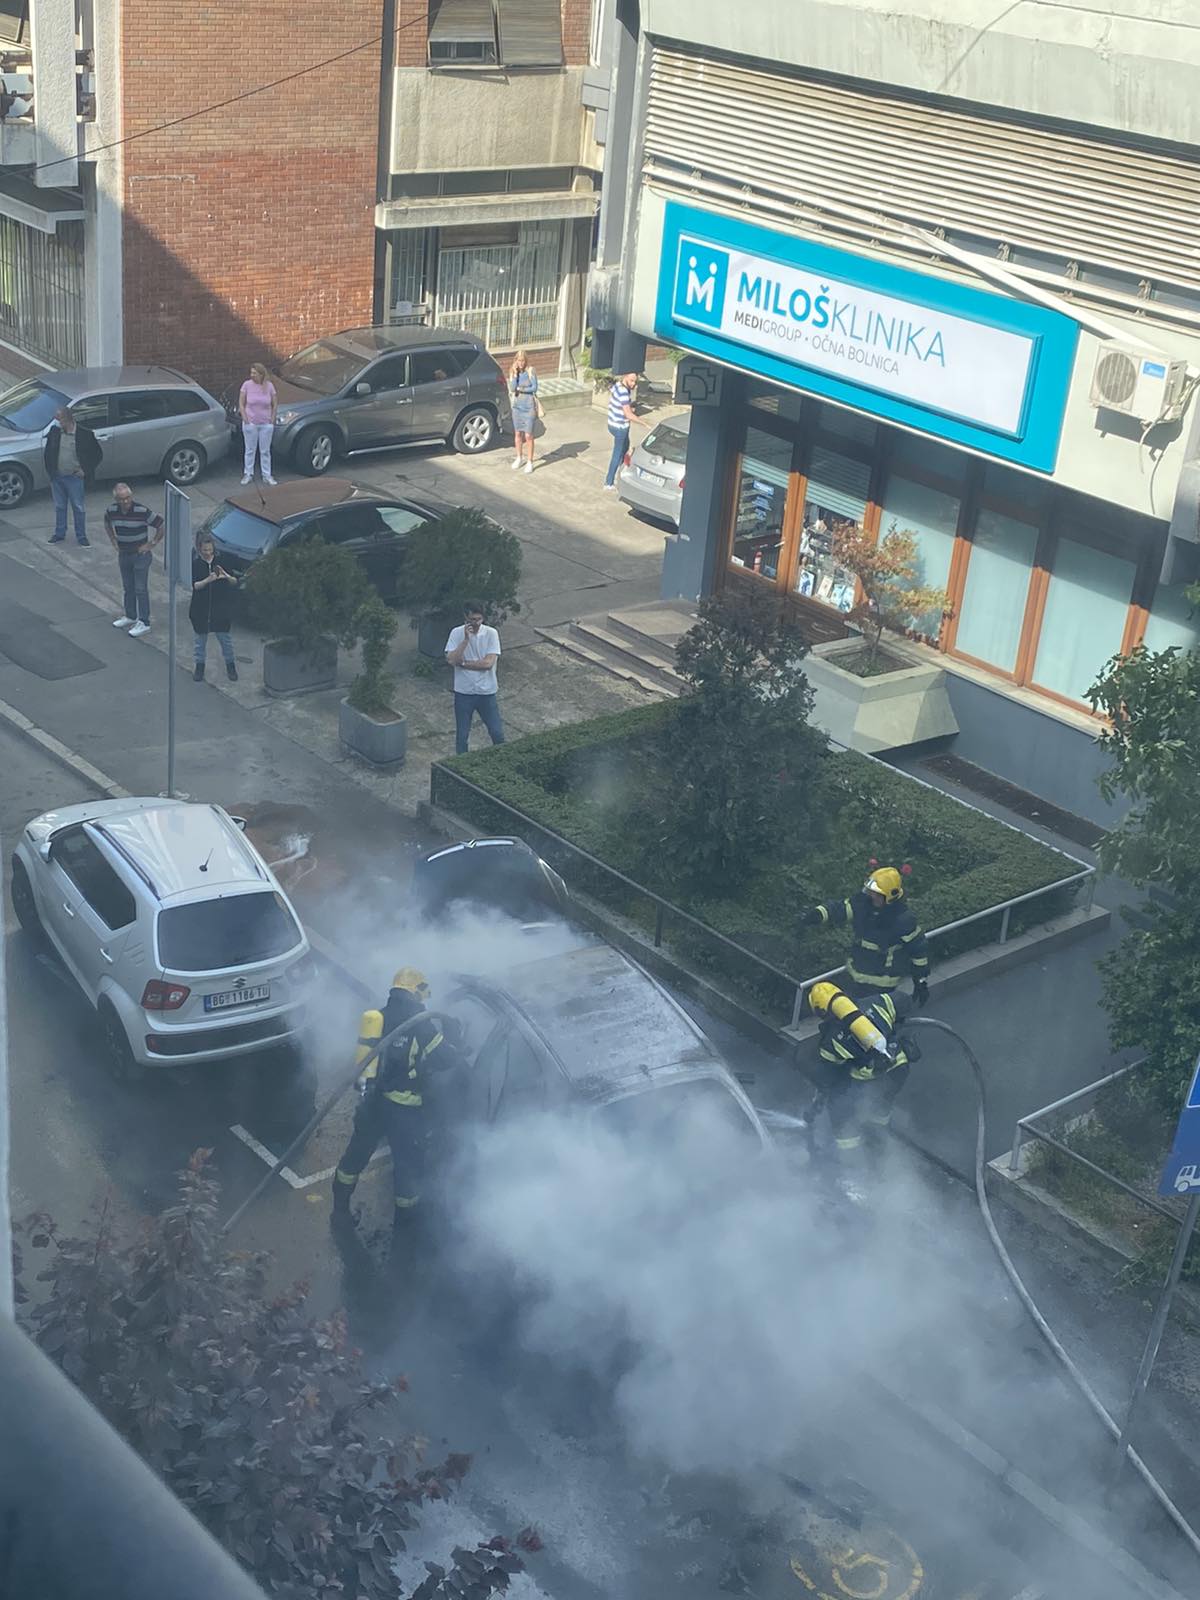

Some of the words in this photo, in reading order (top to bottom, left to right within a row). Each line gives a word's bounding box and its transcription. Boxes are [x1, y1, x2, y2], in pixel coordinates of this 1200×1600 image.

[734, 310, 802, 342] MEDIGROUP
[811, 335, 845, 359] OČNA
[847, 346, 899, 376] BOLNICA
[212, 995, 225, 1007] BG
[257, 986, 269, 998] TU
